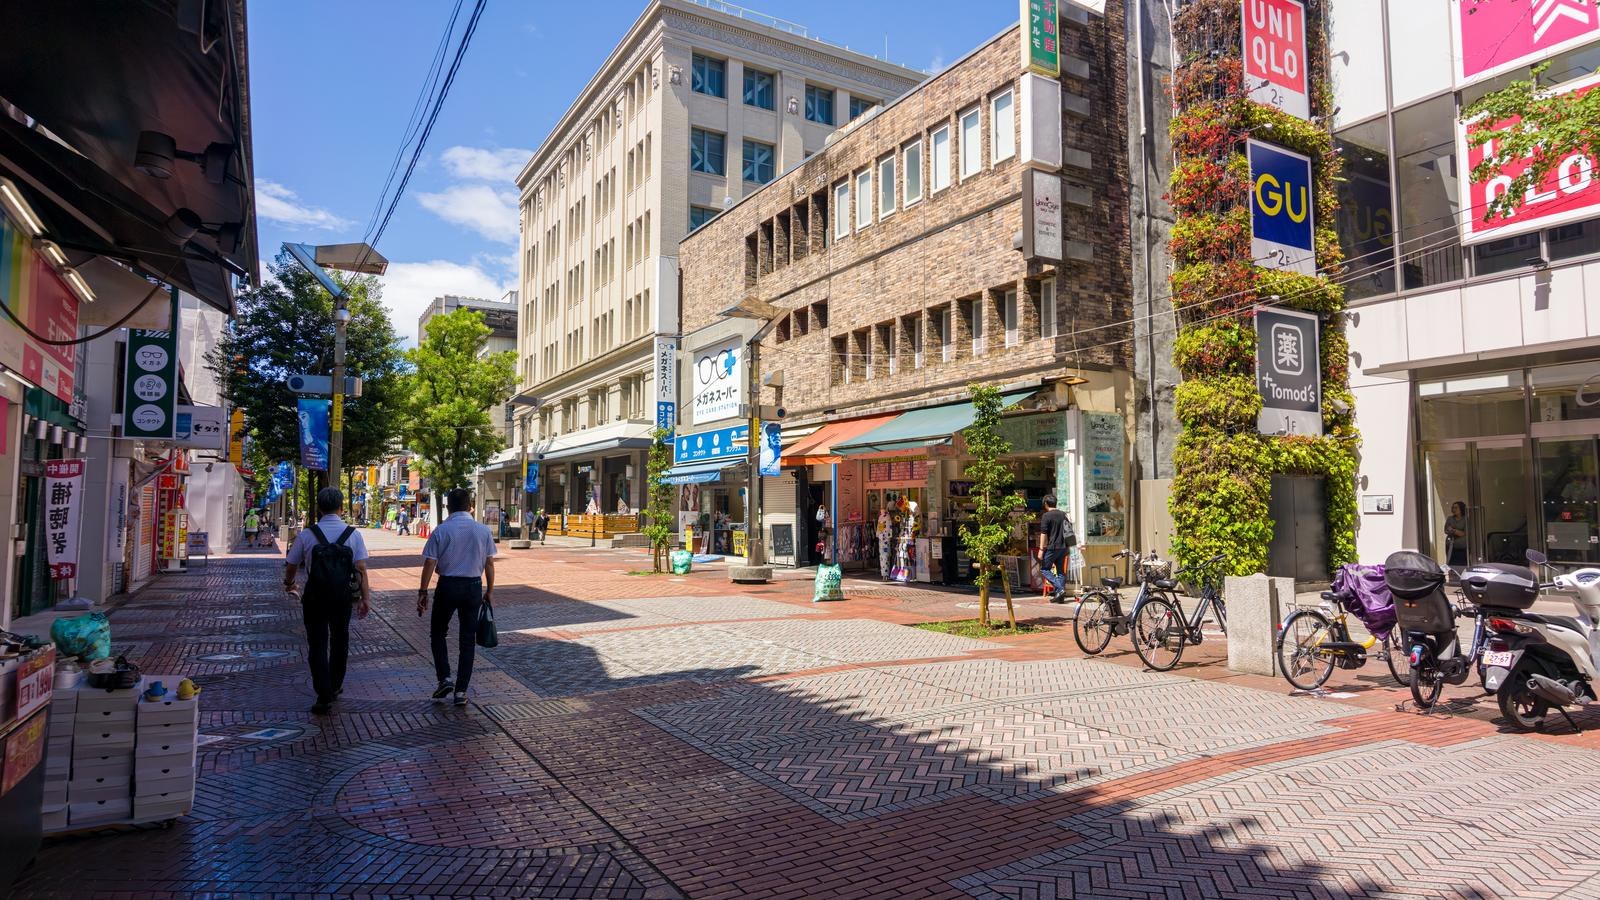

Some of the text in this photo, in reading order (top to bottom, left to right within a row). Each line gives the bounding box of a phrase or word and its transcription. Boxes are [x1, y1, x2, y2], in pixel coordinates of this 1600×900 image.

[1251, 0, 1292, 42] UNI
[1252, 35, 1298, 79] QLO
[1271, 88, 1284, 107] 2F
[1255, 173, 1307, 224] GU
[1278, 250, 1290, 267] 2F
[1277, 332, 1299, 367] 薬
[696, 386, 738, 407] メガネスーパー
[1270, 383, 1315, 403] Tomod's
[1285, 415, 1296, 432] 1F
